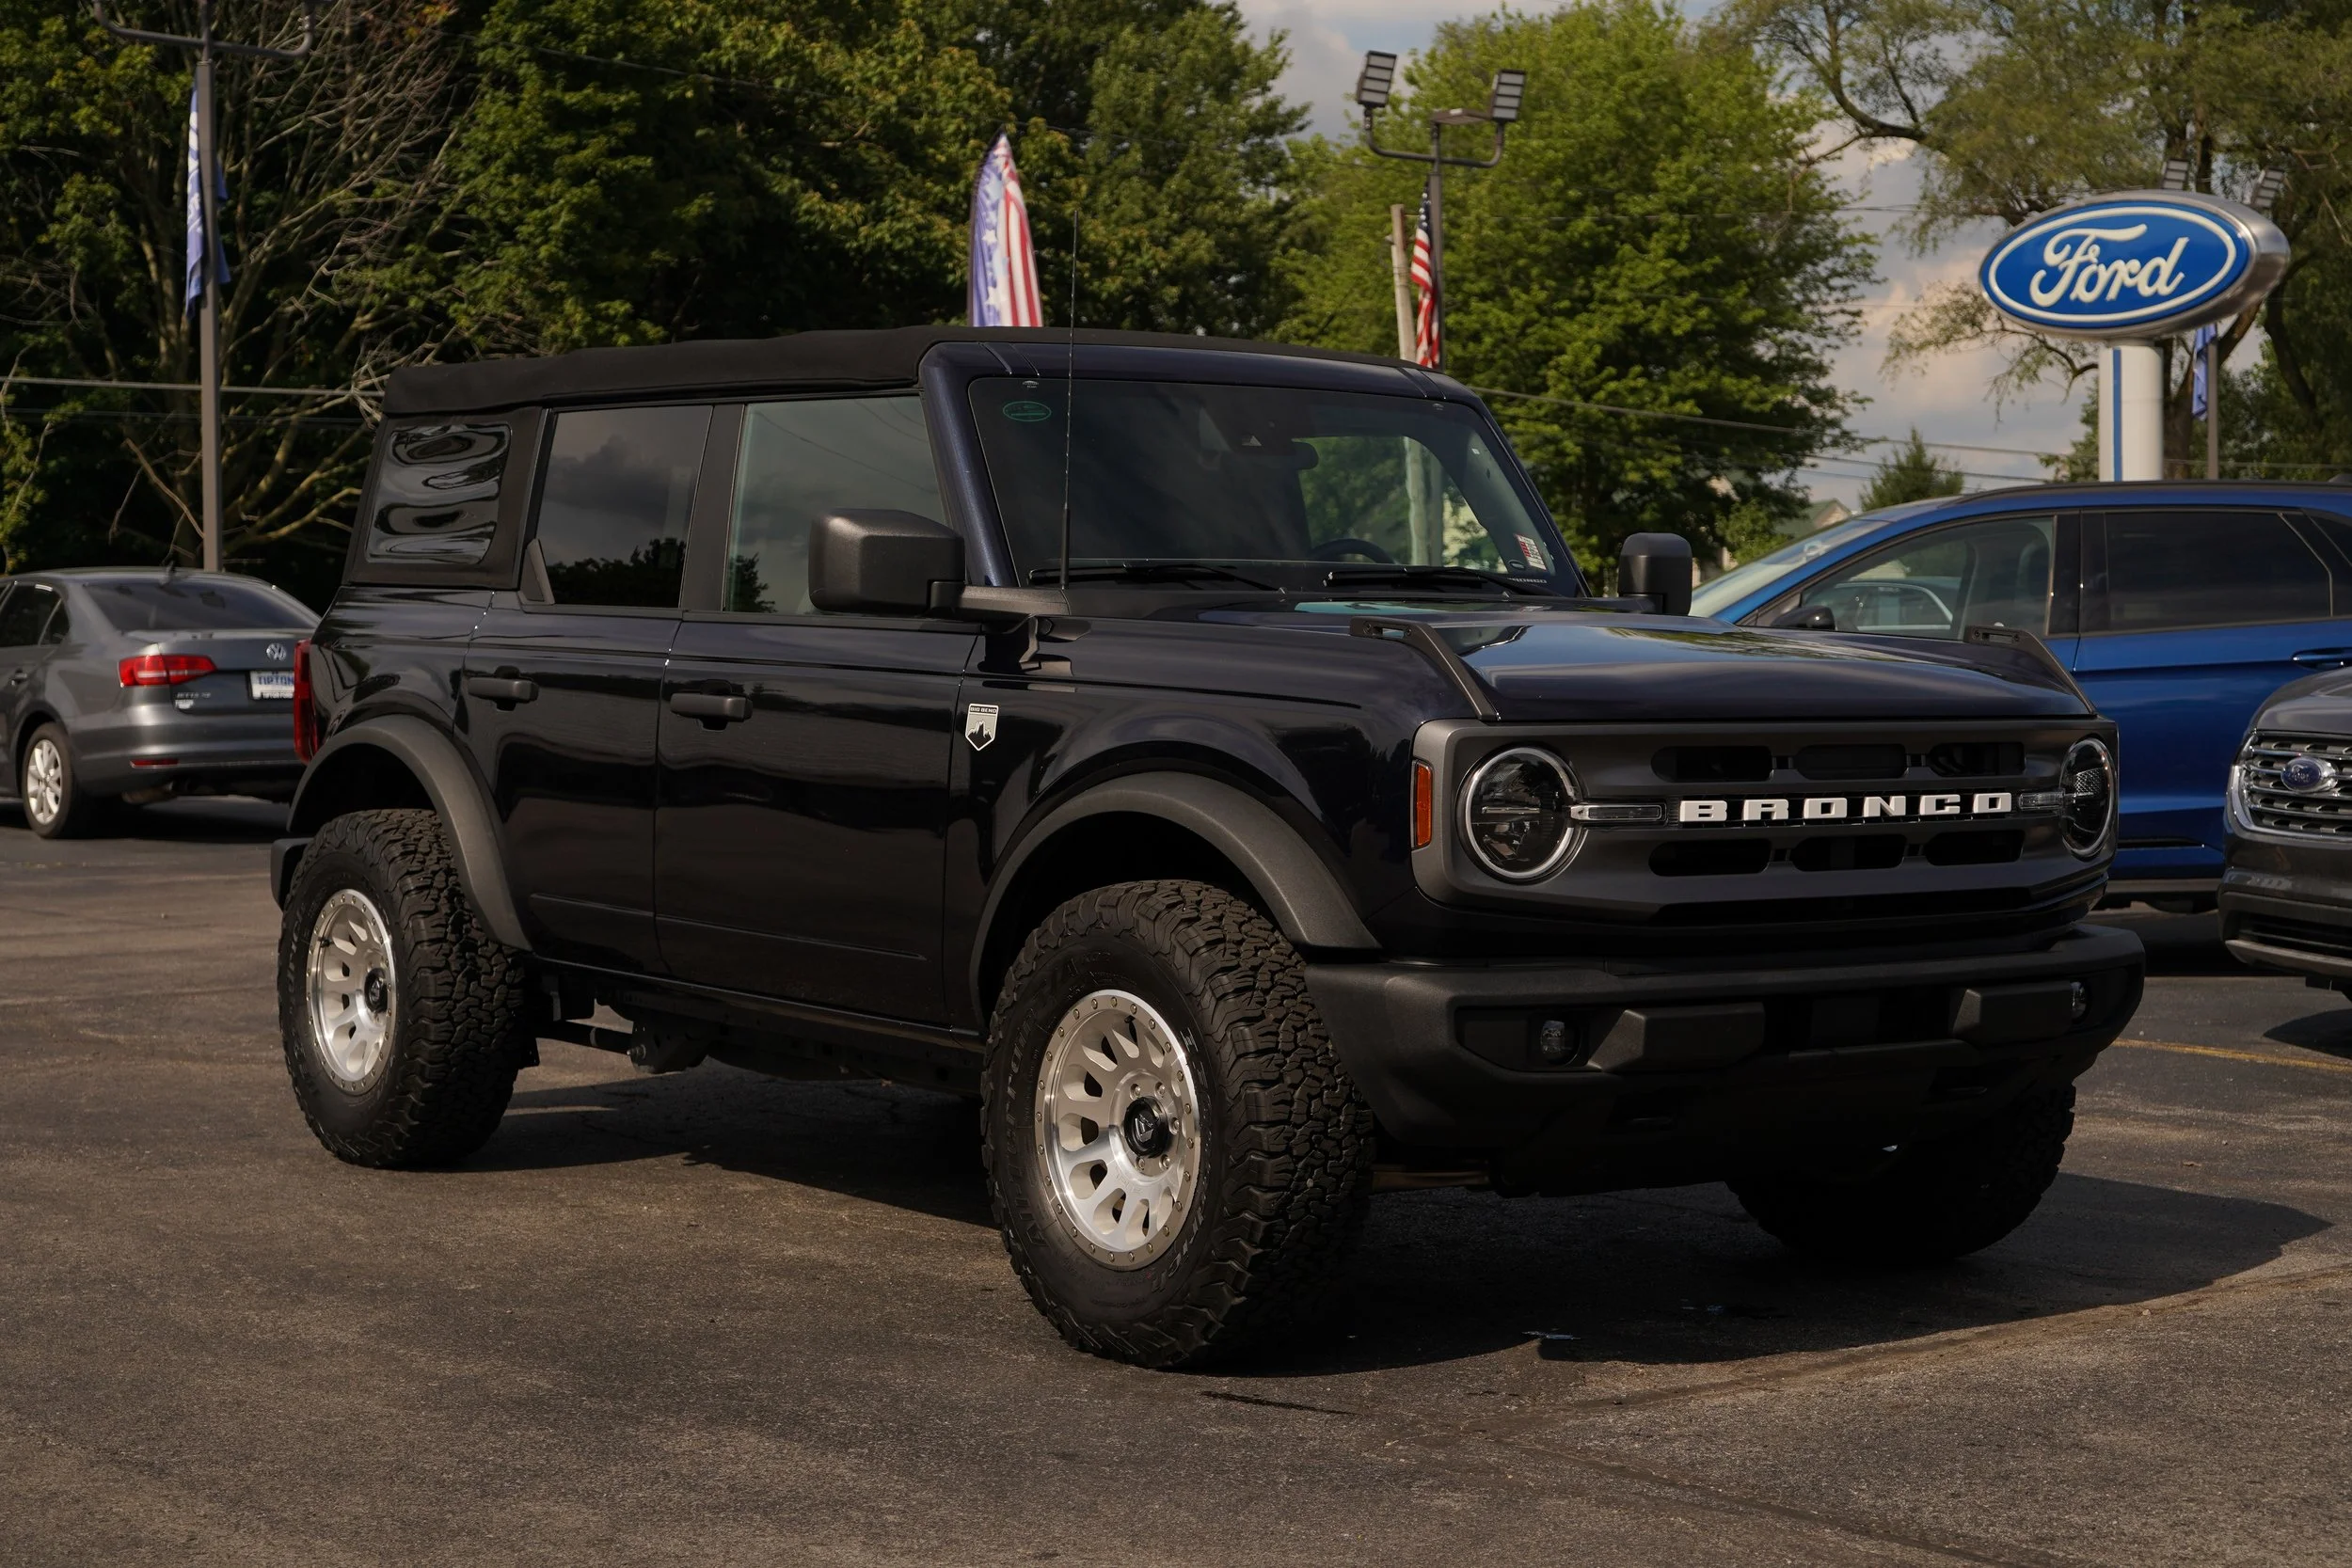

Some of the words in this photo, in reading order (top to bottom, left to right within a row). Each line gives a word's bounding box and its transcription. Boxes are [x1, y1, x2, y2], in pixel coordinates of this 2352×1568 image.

[2029, 223, 2189, 308] Ford
[258, 675, 294, 685] TIPTON
[1678, 791, 2012, 823] BRONCO
